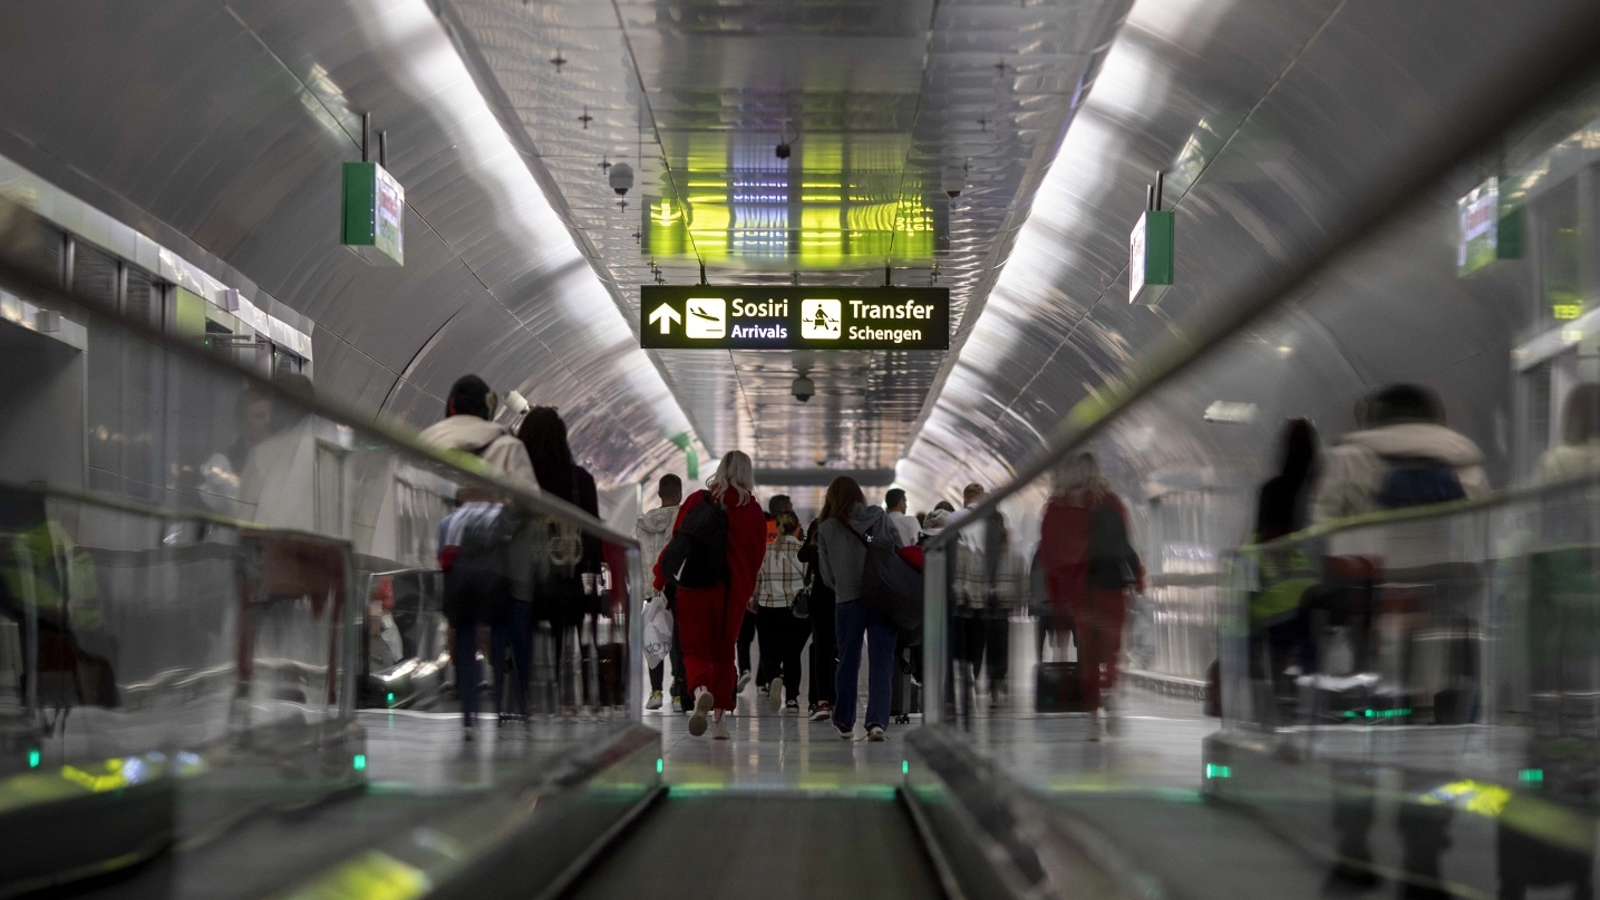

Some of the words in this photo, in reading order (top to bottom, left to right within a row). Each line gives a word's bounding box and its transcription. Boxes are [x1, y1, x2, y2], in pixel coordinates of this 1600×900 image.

[732, 298, 788, 317] Sosiri
[849, 300, 934, 320] Transfer
[731, 324, 788, 339] Arrivals
[849, 326, 922, 343] Schengen
